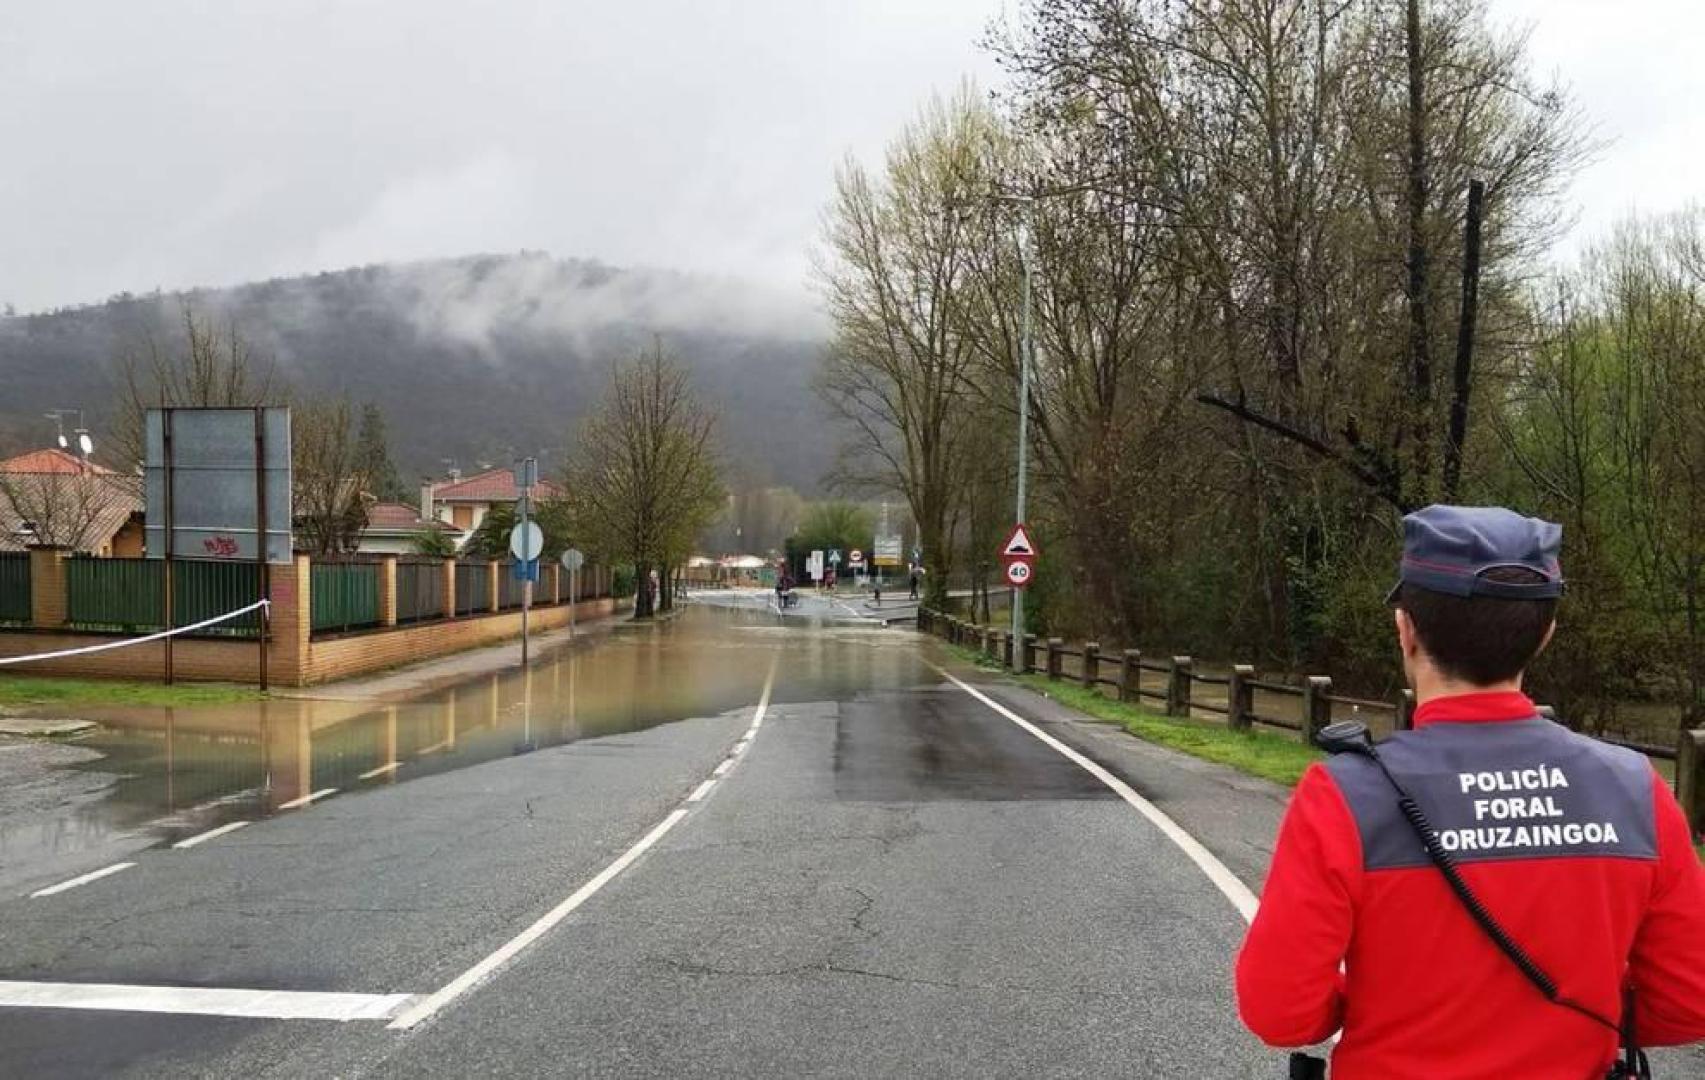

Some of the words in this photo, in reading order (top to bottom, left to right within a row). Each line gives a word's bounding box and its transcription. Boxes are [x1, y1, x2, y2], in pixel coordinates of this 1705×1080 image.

[1011, 567, 1026, 577] 40
[1459, 764, 1568, 793] POLICÍA
[1474, 796, 1563, 820] FORAL
[1424, 822, 1619, 851] ORUZAINGOA
